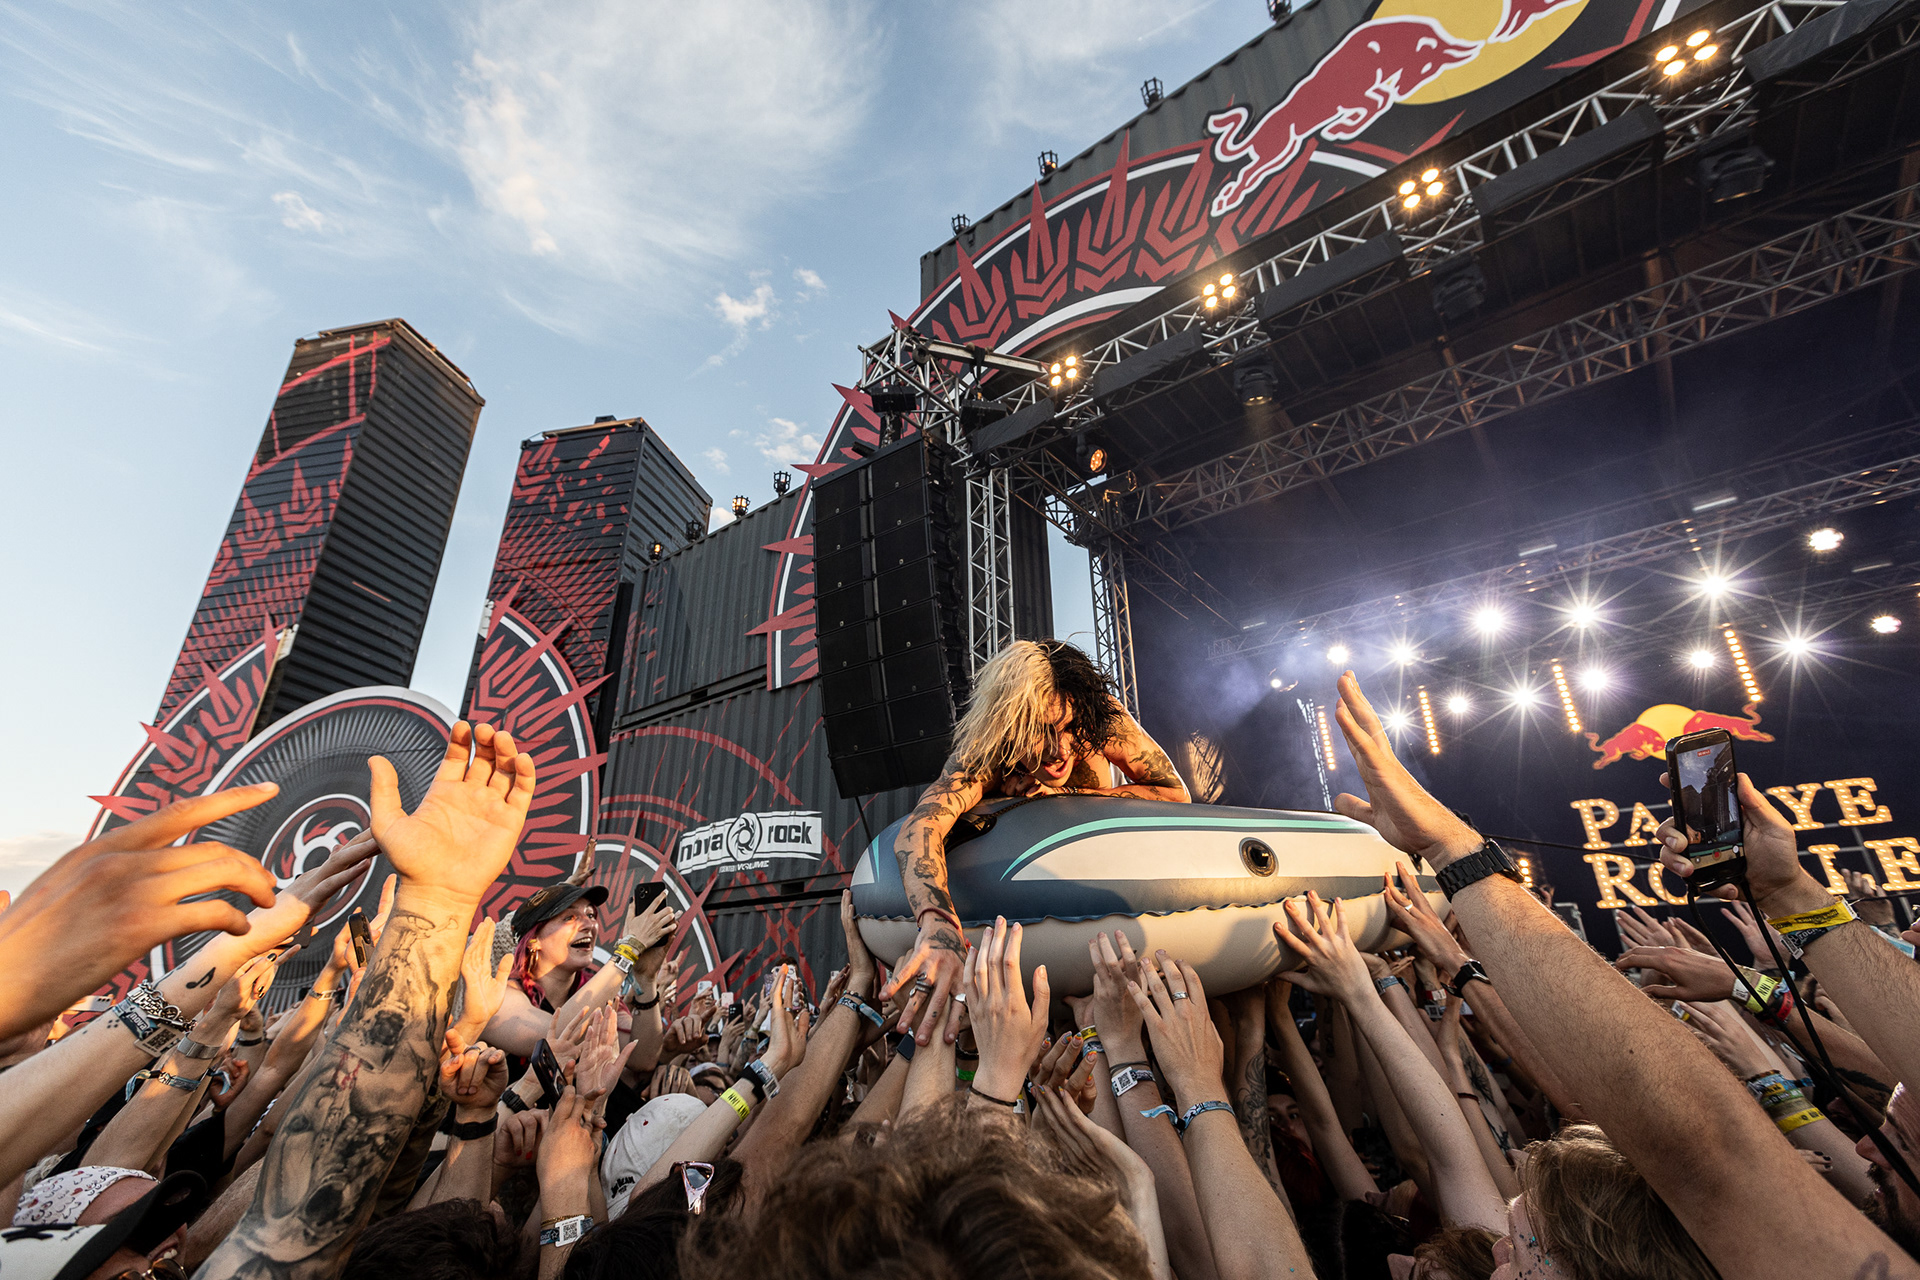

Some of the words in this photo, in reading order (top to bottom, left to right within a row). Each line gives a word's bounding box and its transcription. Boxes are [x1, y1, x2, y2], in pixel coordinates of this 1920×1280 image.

[680, 832, 723, 862] nova
[767, 821, 812, 845] rock
[1570, 777, 1893, 850] PAYE
[1583, 836, 1920, 909] ROLE
[129, 1012, 148, 1031] nova
